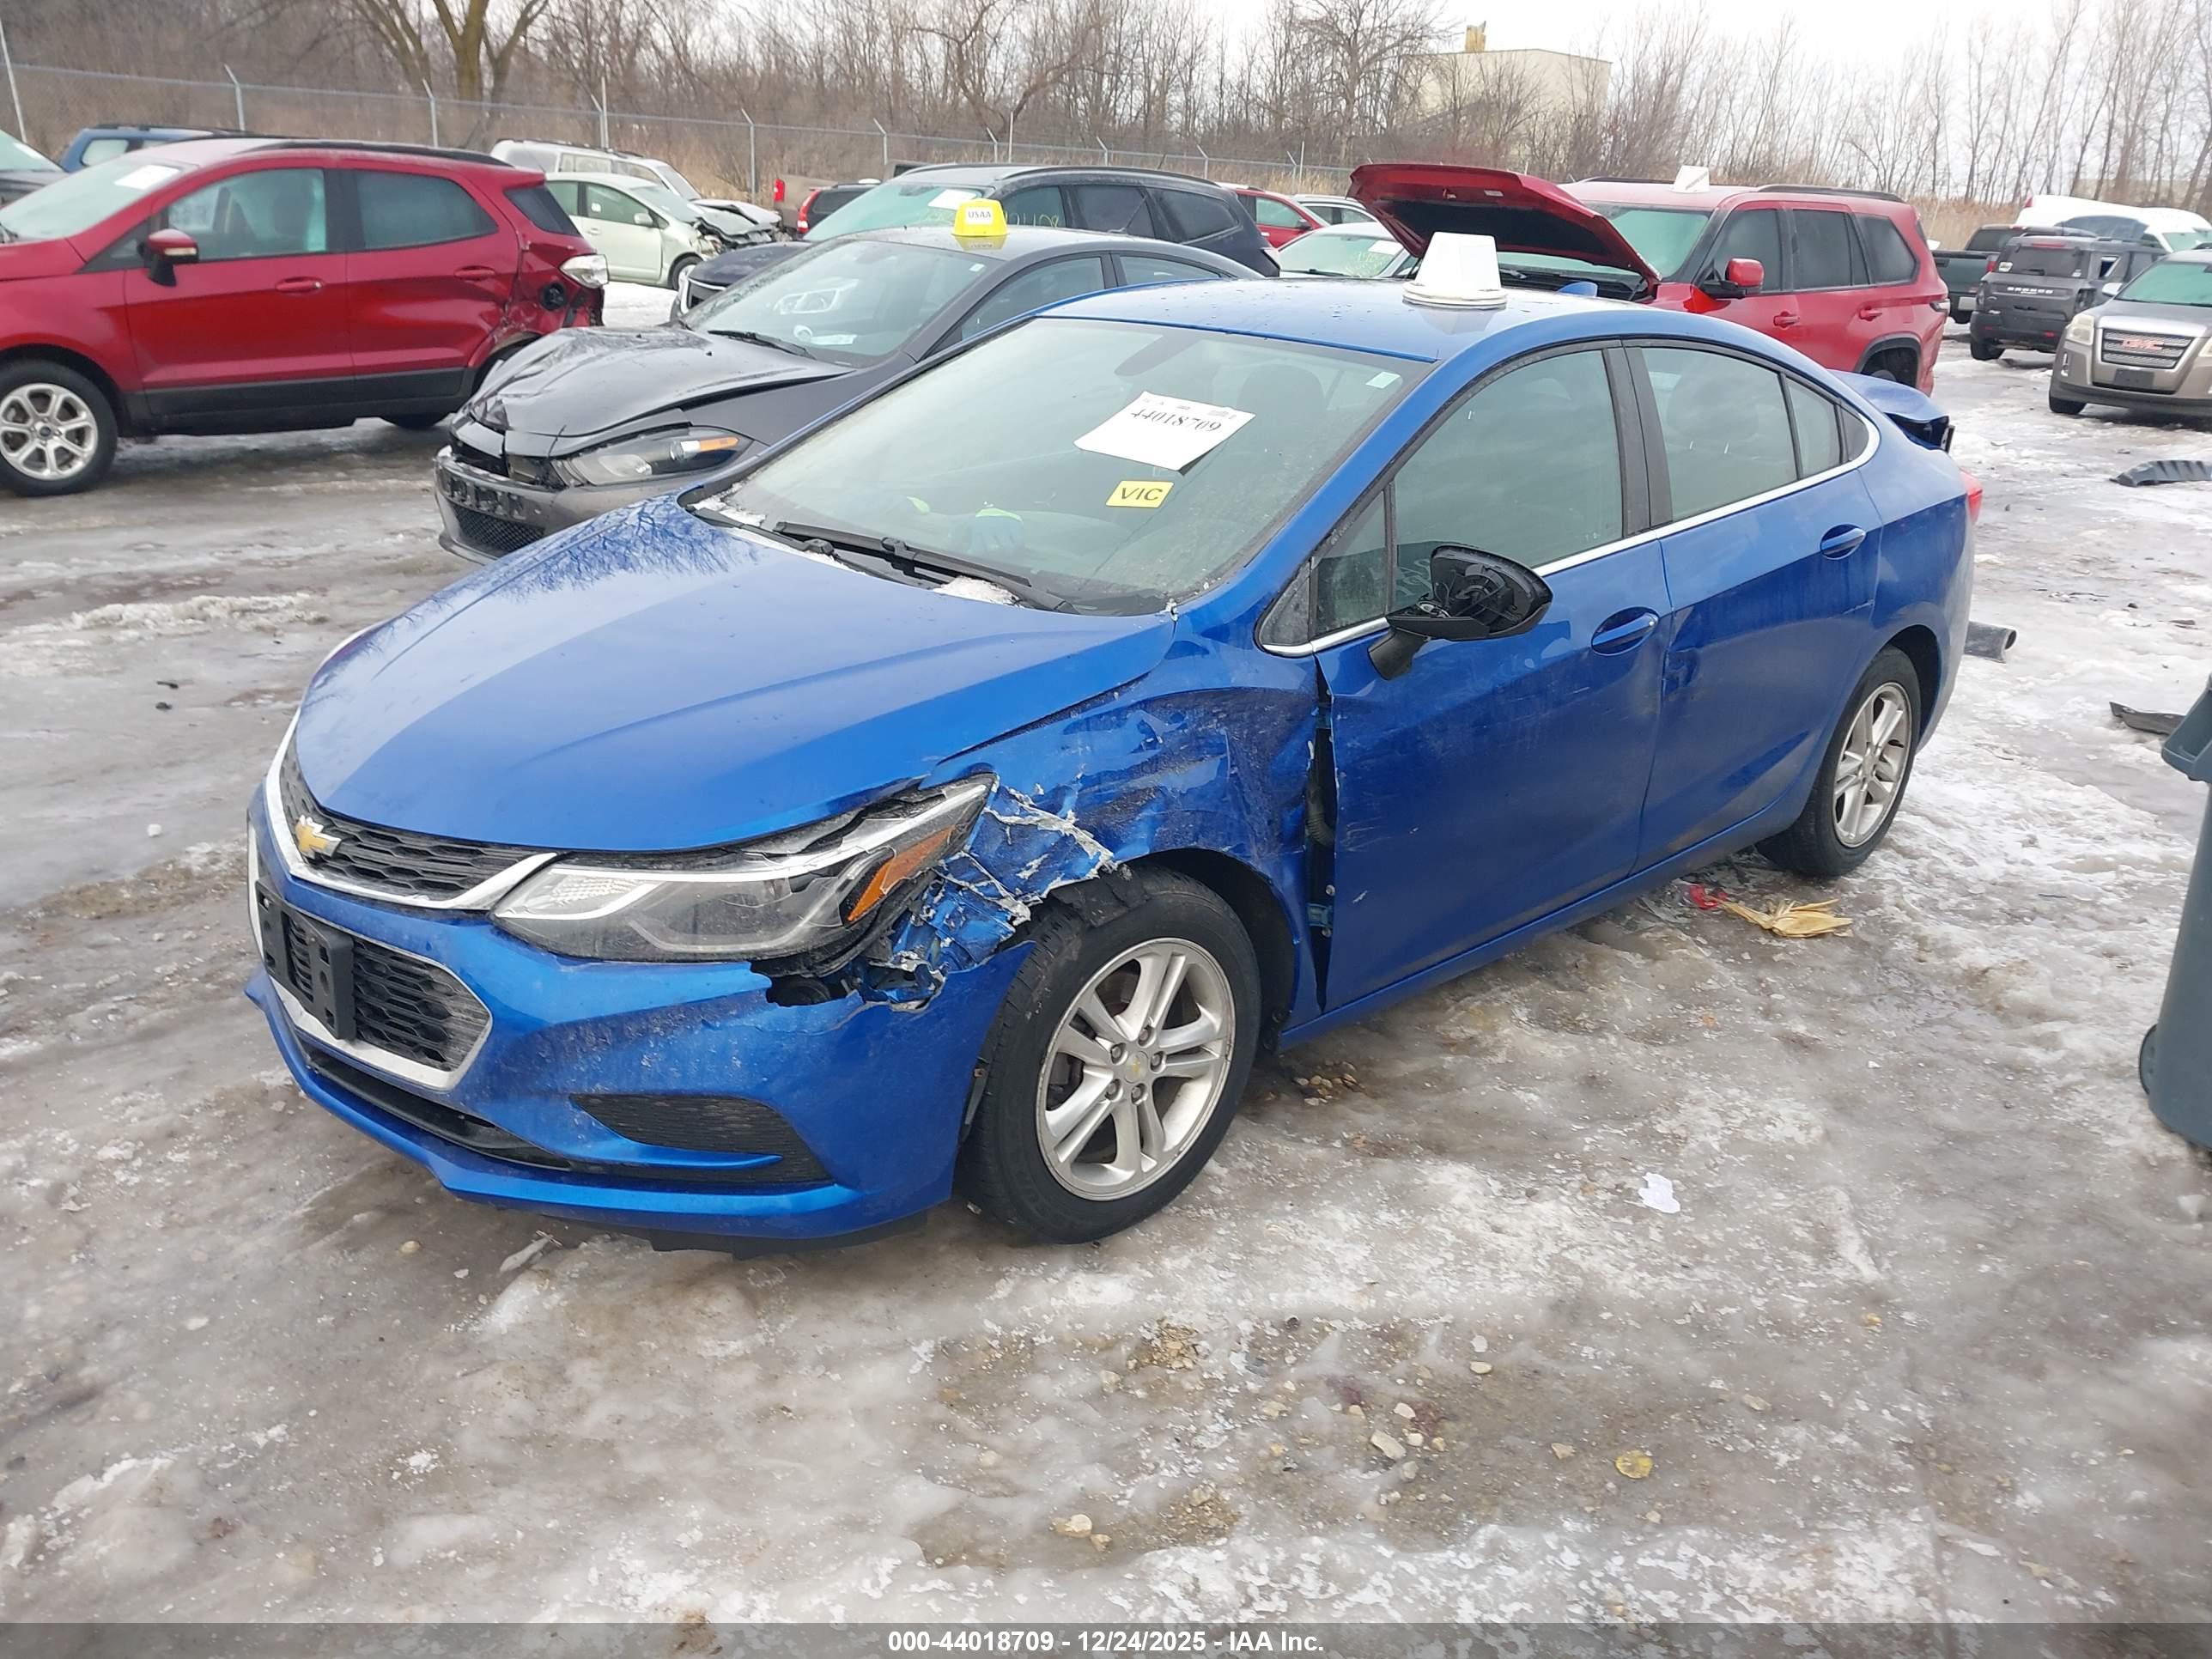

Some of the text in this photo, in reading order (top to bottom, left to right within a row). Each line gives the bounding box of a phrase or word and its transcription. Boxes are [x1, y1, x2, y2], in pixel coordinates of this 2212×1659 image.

[968, 210, 992, 219] USAA
[2122, 337, 2165, 350] GMC
[1130, 408, 1222, 432] 44018709
[1121, 487, 1164, 501] VIC
